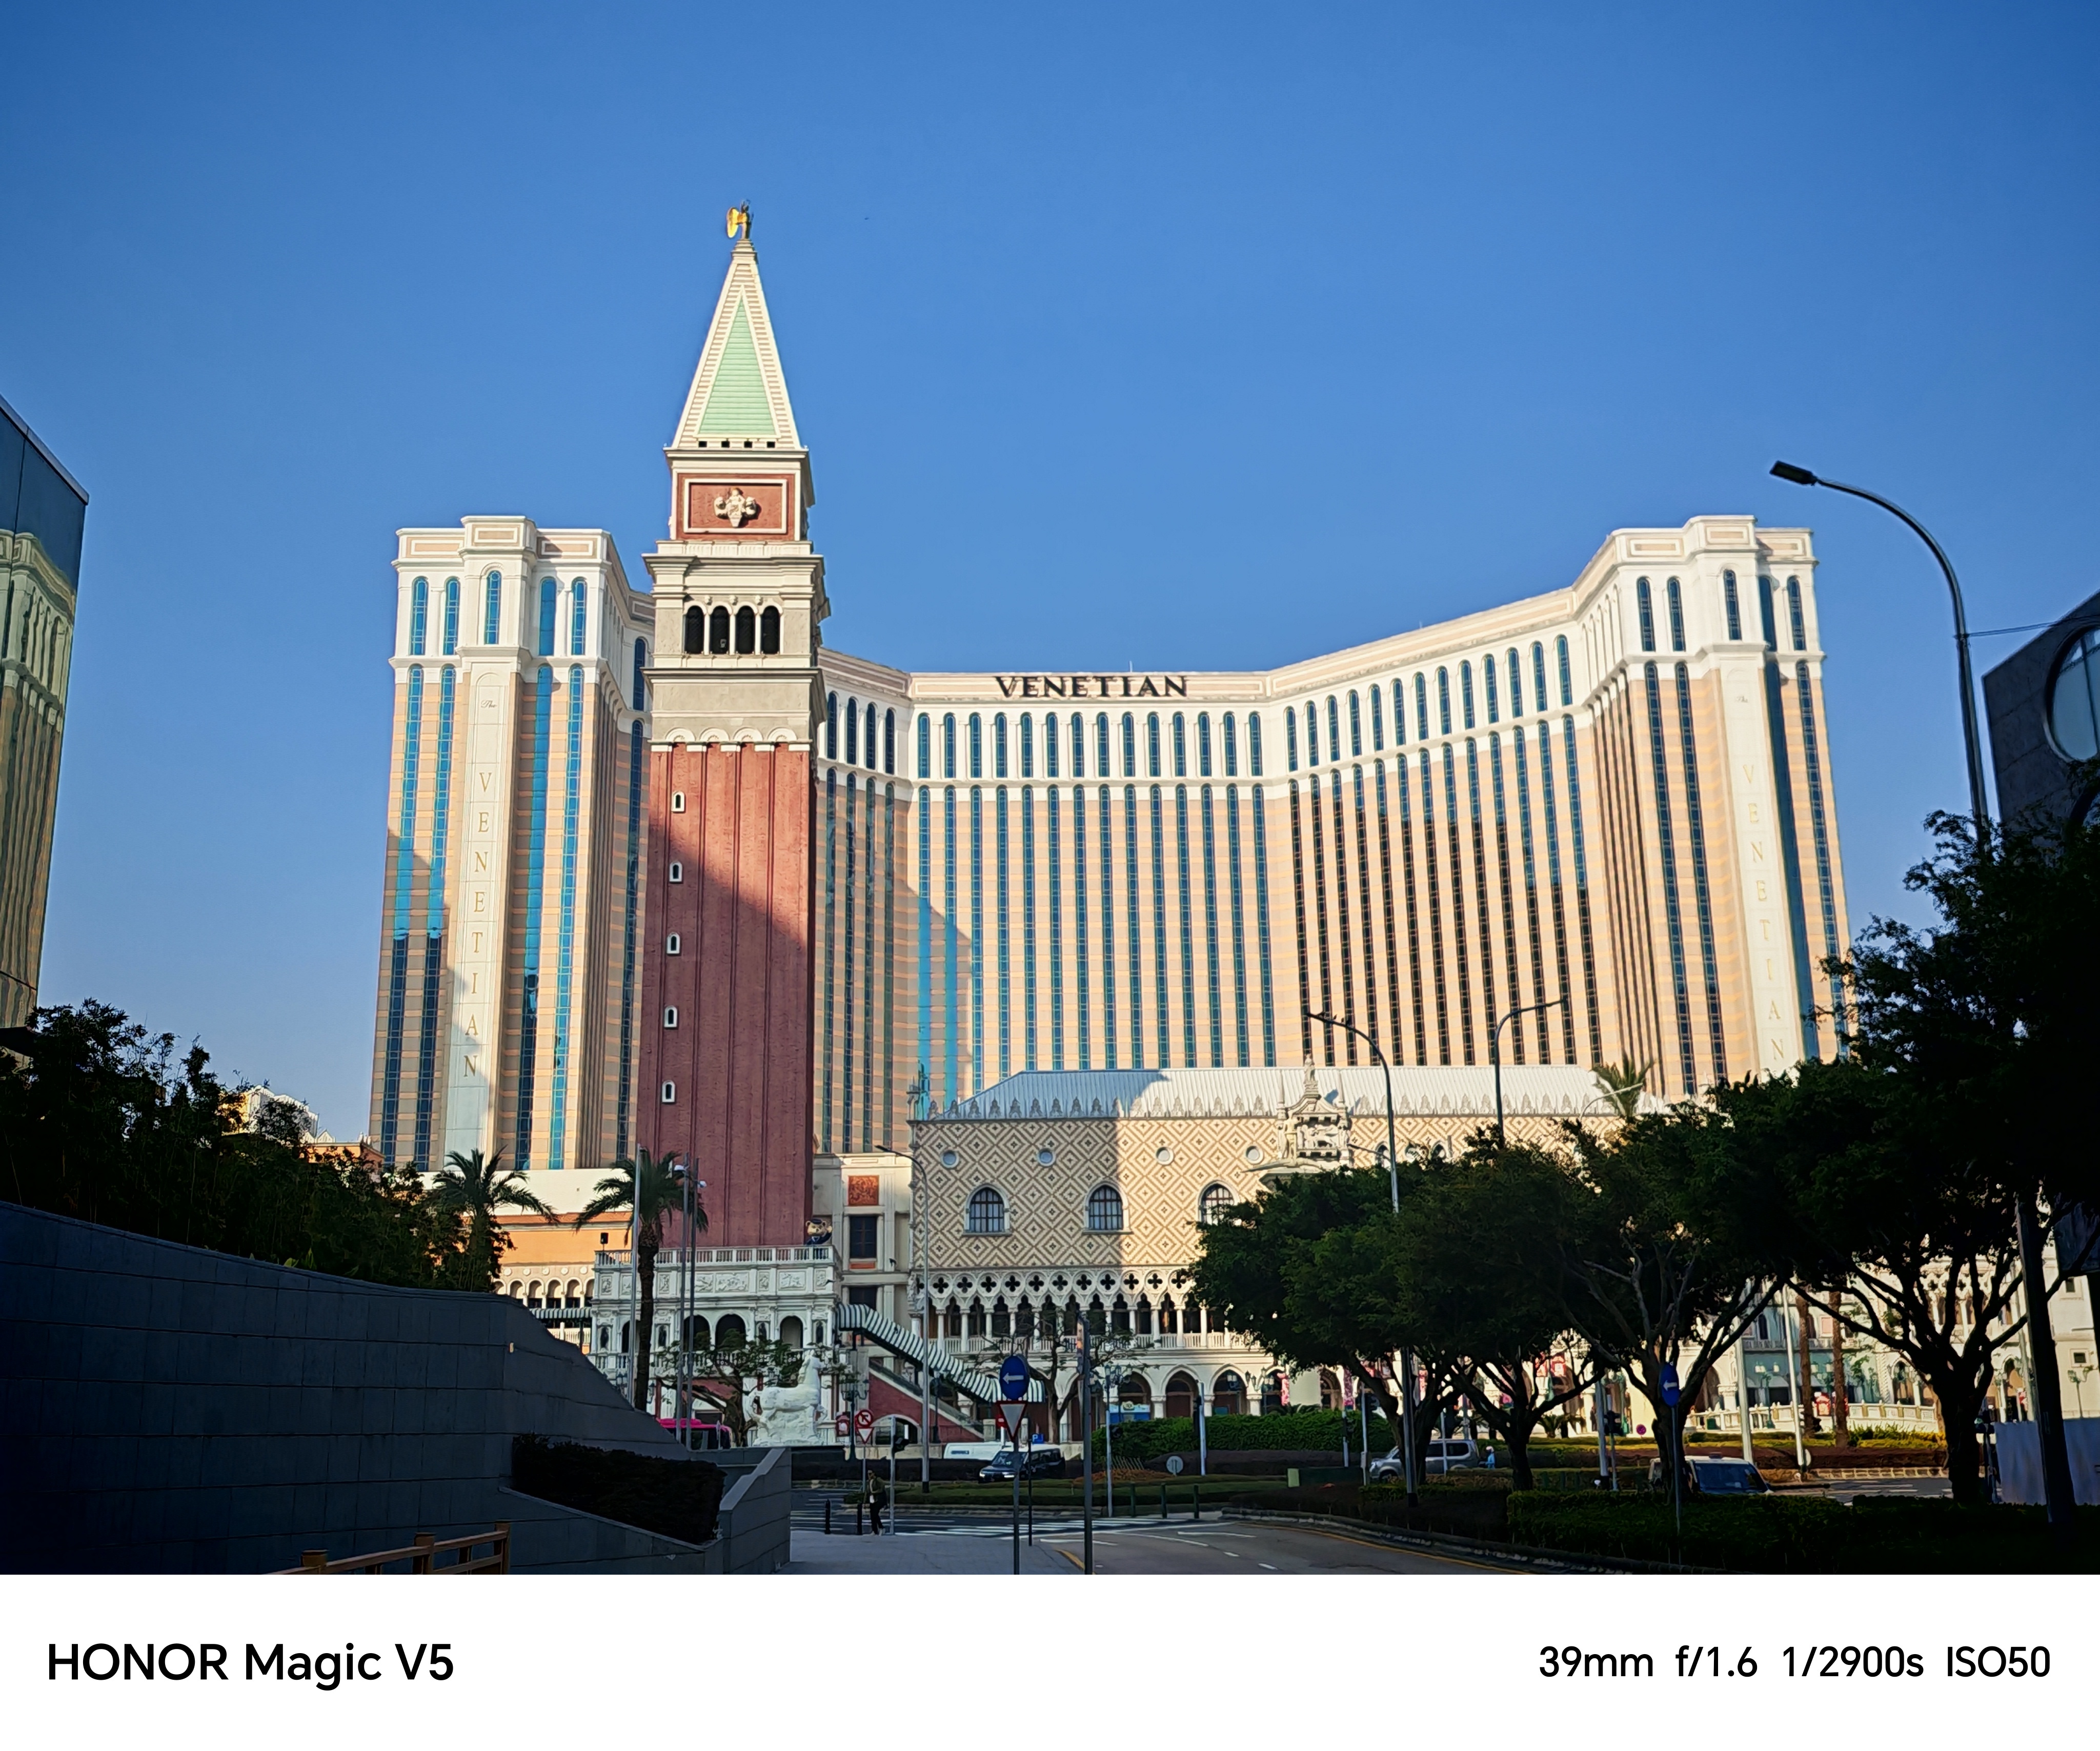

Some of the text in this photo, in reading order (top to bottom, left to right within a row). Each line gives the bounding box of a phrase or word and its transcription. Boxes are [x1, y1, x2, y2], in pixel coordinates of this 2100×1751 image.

[995, 676, 1187, 697] VENETIAN
[464, 700, 497, 1077] The VENETIAN
[1743, 764, 1784, 1062] VENETIAN
